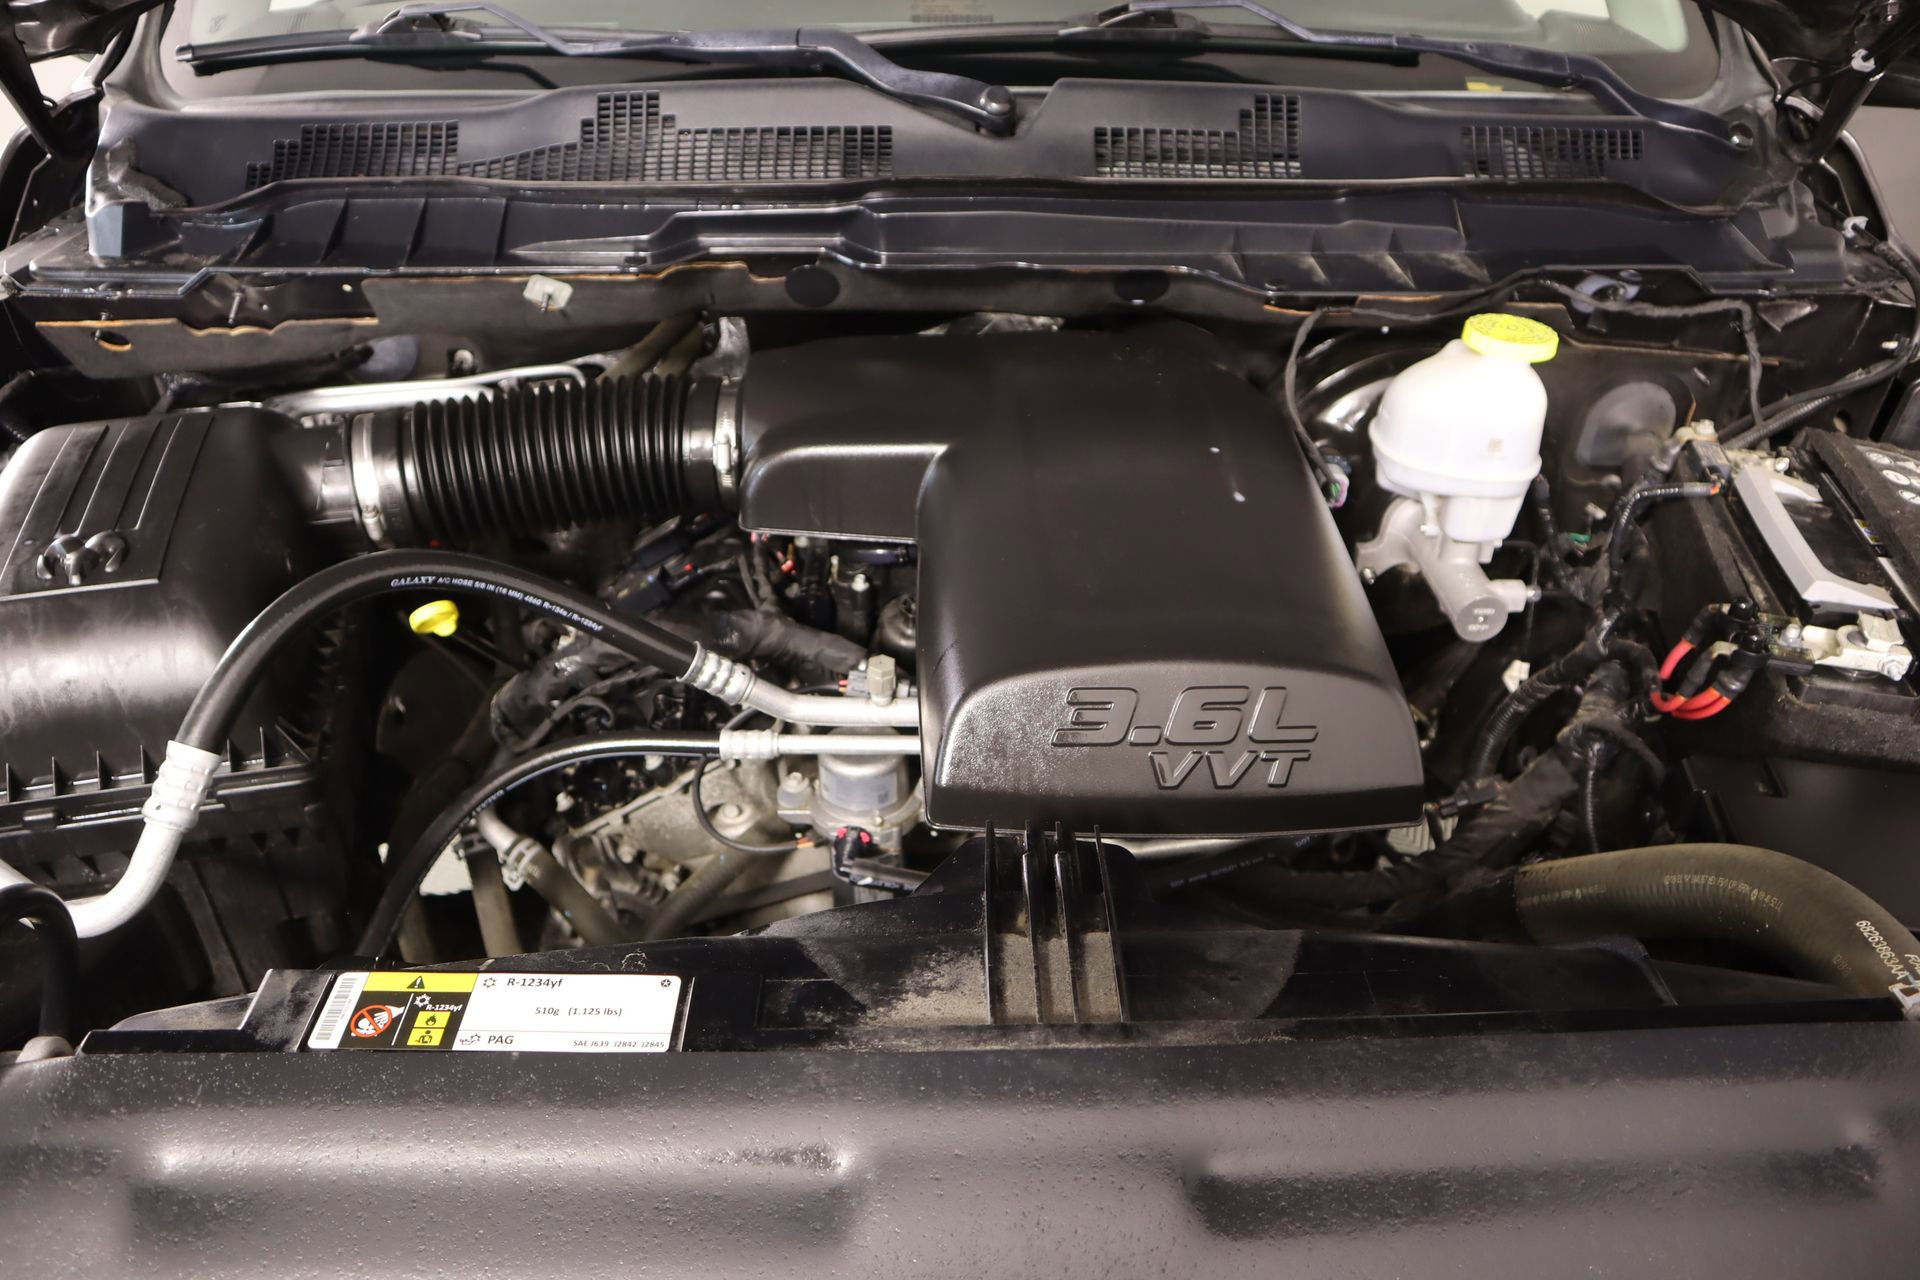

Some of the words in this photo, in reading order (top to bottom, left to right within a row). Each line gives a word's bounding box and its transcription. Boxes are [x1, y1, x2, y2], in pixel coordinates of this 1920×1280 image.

[390, 576, 436, 588] GALAXY
[452, 578, 473, 587] HOSE
[487, 583, 495, 591] IN
[572, 613, 603, 631] R-1234yf
[1050, 685, 1319, 747] 3.6L
[1148, 749, 1312, 790] VVT
[1855, 920, 1910, 980] 68263863AA
[507, 977, 563, 988] R-1234yf
[425, 1004, 463, 1012] R-1234yf
[535, 1006, 560, 1016] 510g
[568, 1007, 601, 1016] (1.125
[603, 1007, 623, 1016] lbs)
[487, 1035, 515, 1045] PAG
[573, 1039, 589, 1047] SAE
